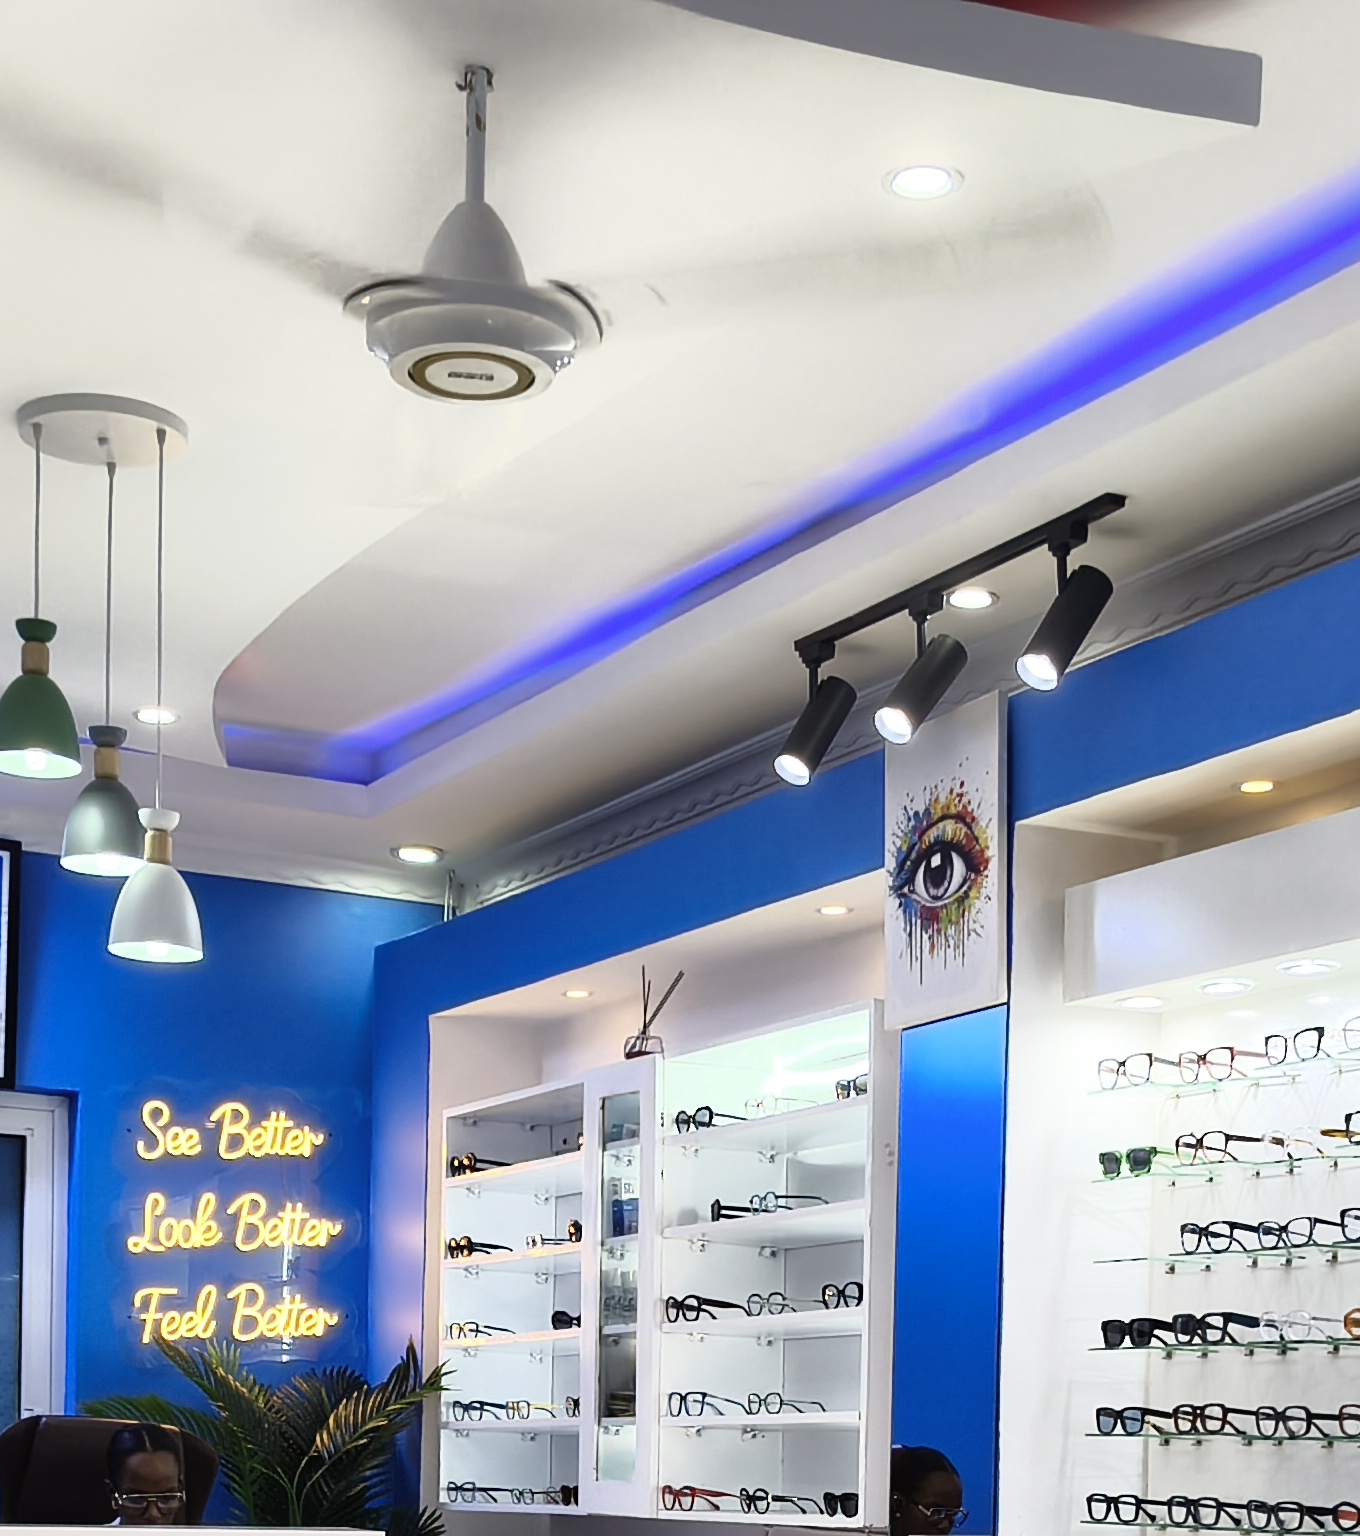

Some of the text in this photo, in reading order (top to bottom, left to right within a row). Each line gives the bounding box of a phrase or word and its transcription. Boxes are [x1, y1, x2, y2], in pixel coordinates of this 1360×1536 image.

[137, 1099, 325, 1160] See Better
[127, 1192, 342, 1254] Look Better
[134, 1282, 339, 1344] Feel Better
